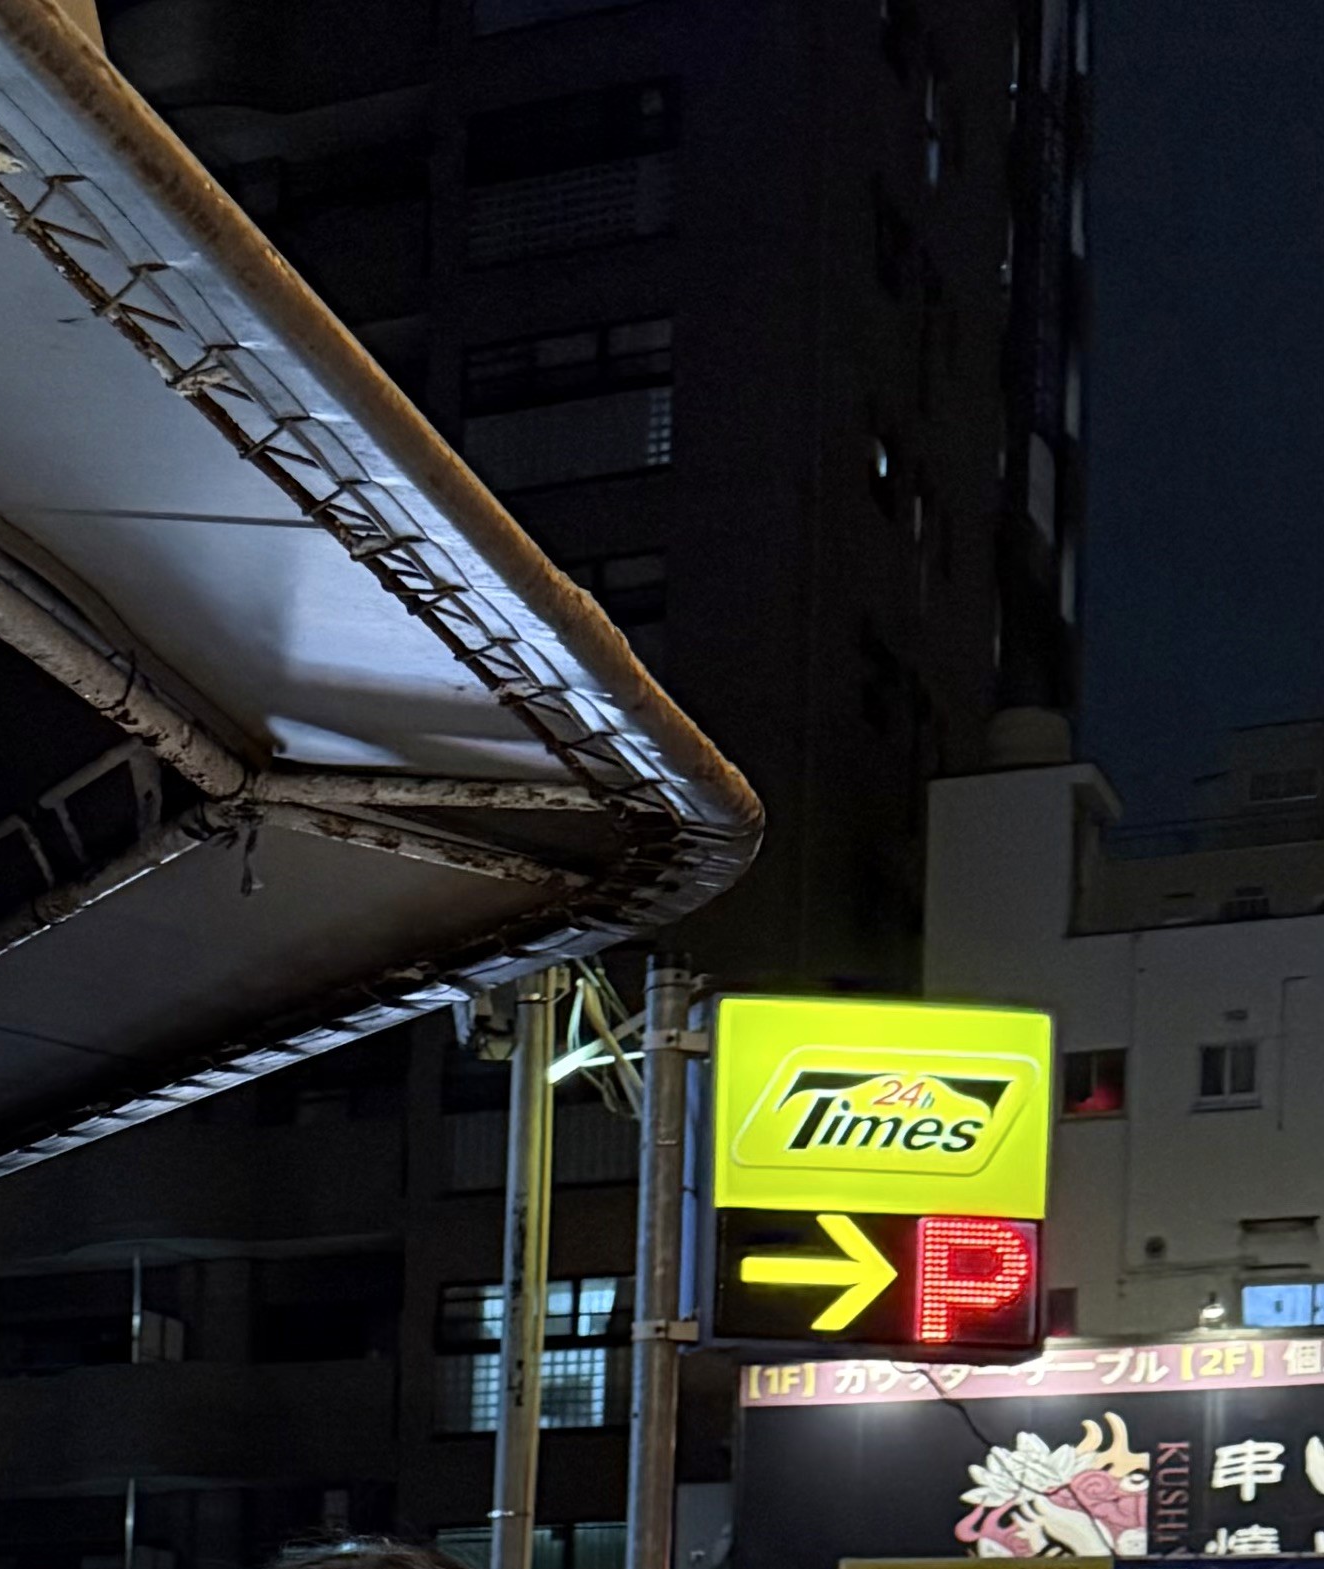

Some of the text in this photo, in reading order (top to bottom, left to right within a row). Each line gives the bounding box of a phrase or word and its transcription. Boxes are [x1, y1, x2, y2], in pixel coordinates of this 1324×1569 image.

[775, 1071, 1013, 1153] Times
[872, 1079, 936, 1109] 24h
[920, 1219, 1029, 1344] P
